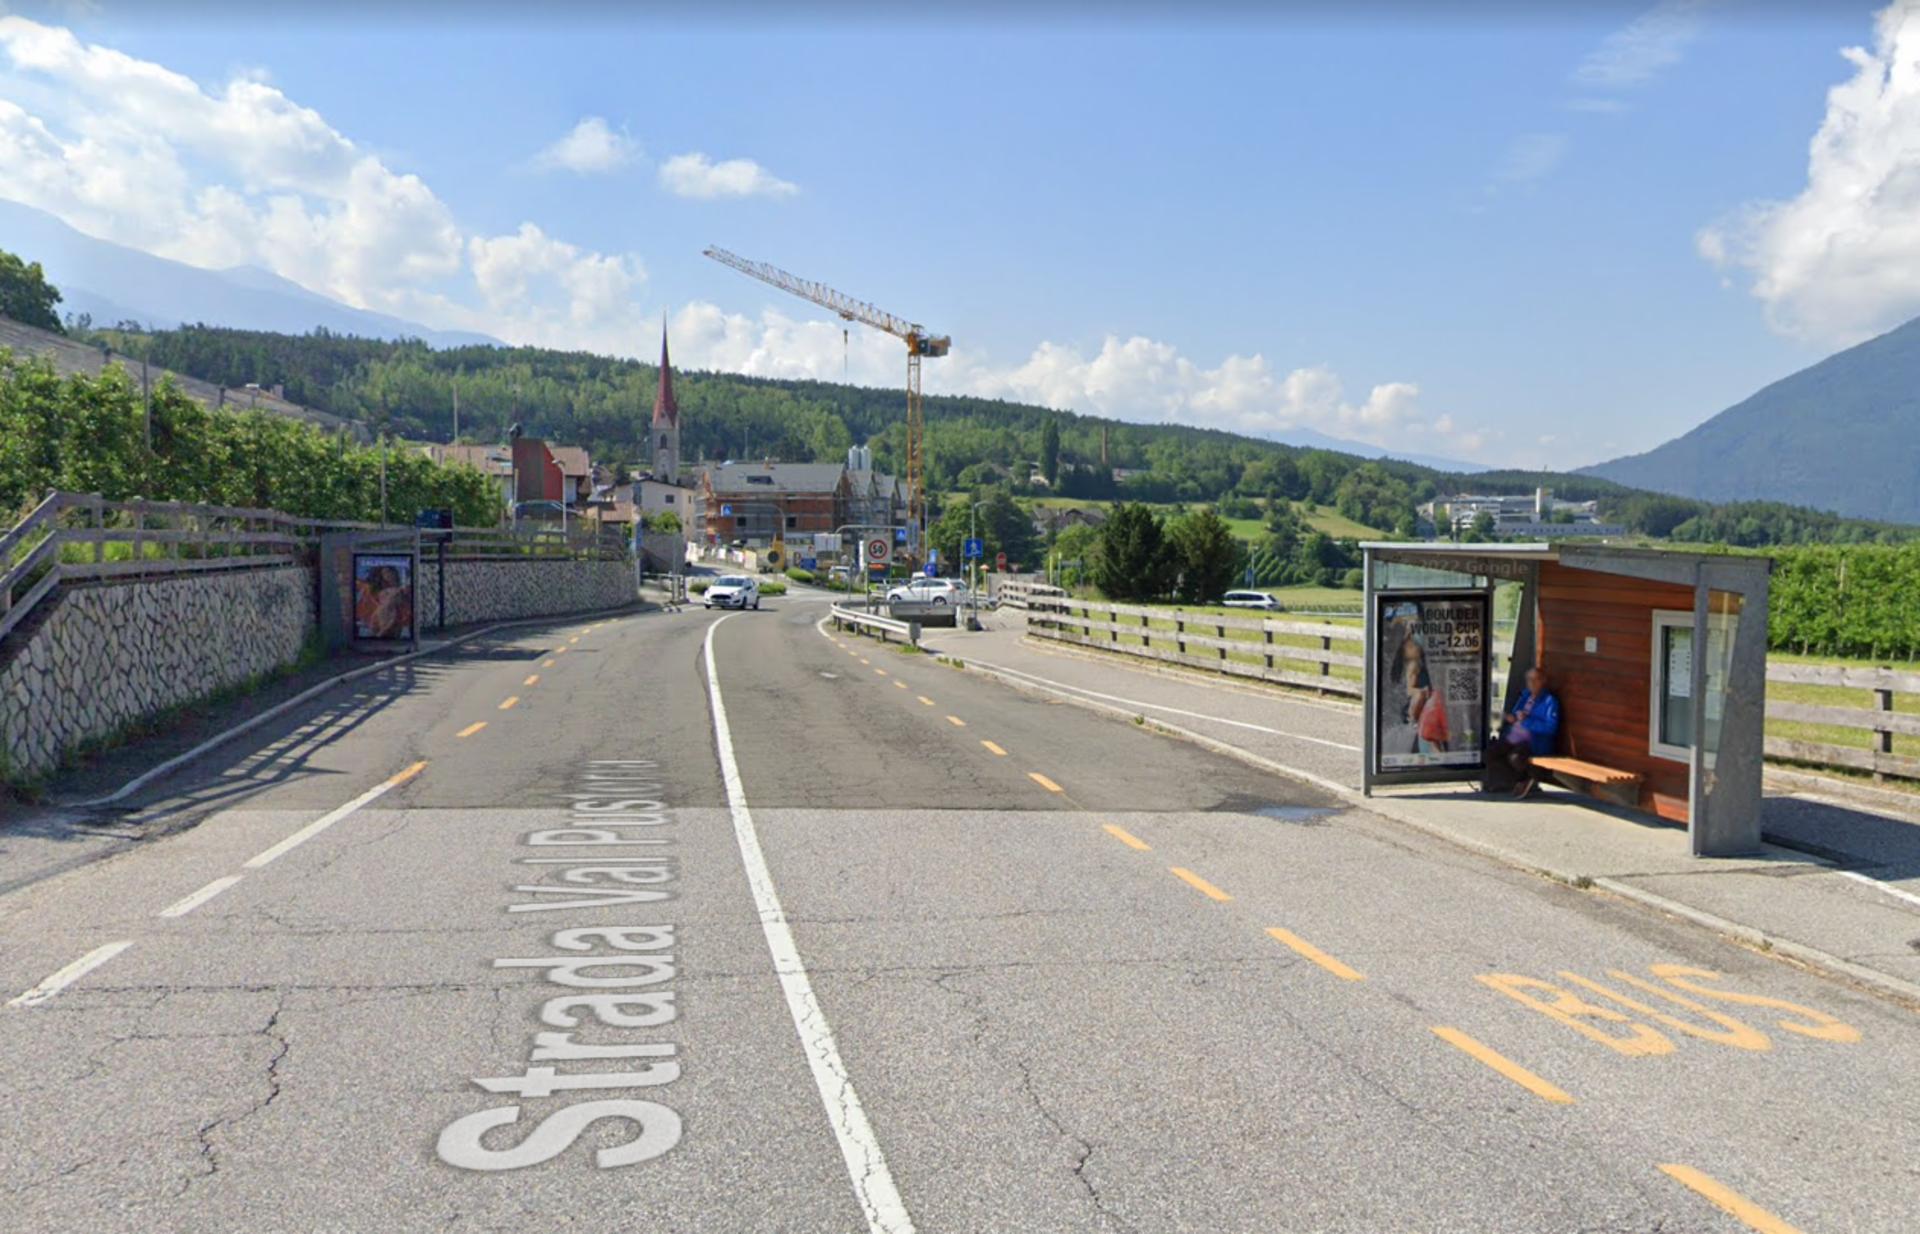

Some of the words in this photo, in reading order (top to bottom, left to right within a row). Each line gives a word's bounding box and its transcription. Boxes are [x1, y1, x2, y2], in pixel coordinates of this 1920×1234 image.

[873, 544, 884, 554] 50
[1425, 608, 1479, 620] BOULDER
[1411, 622, 1452, 634] WORLD
[1455, 621, 1480, 634] CUP
[1473, 963, 1862, 1057] BUS
